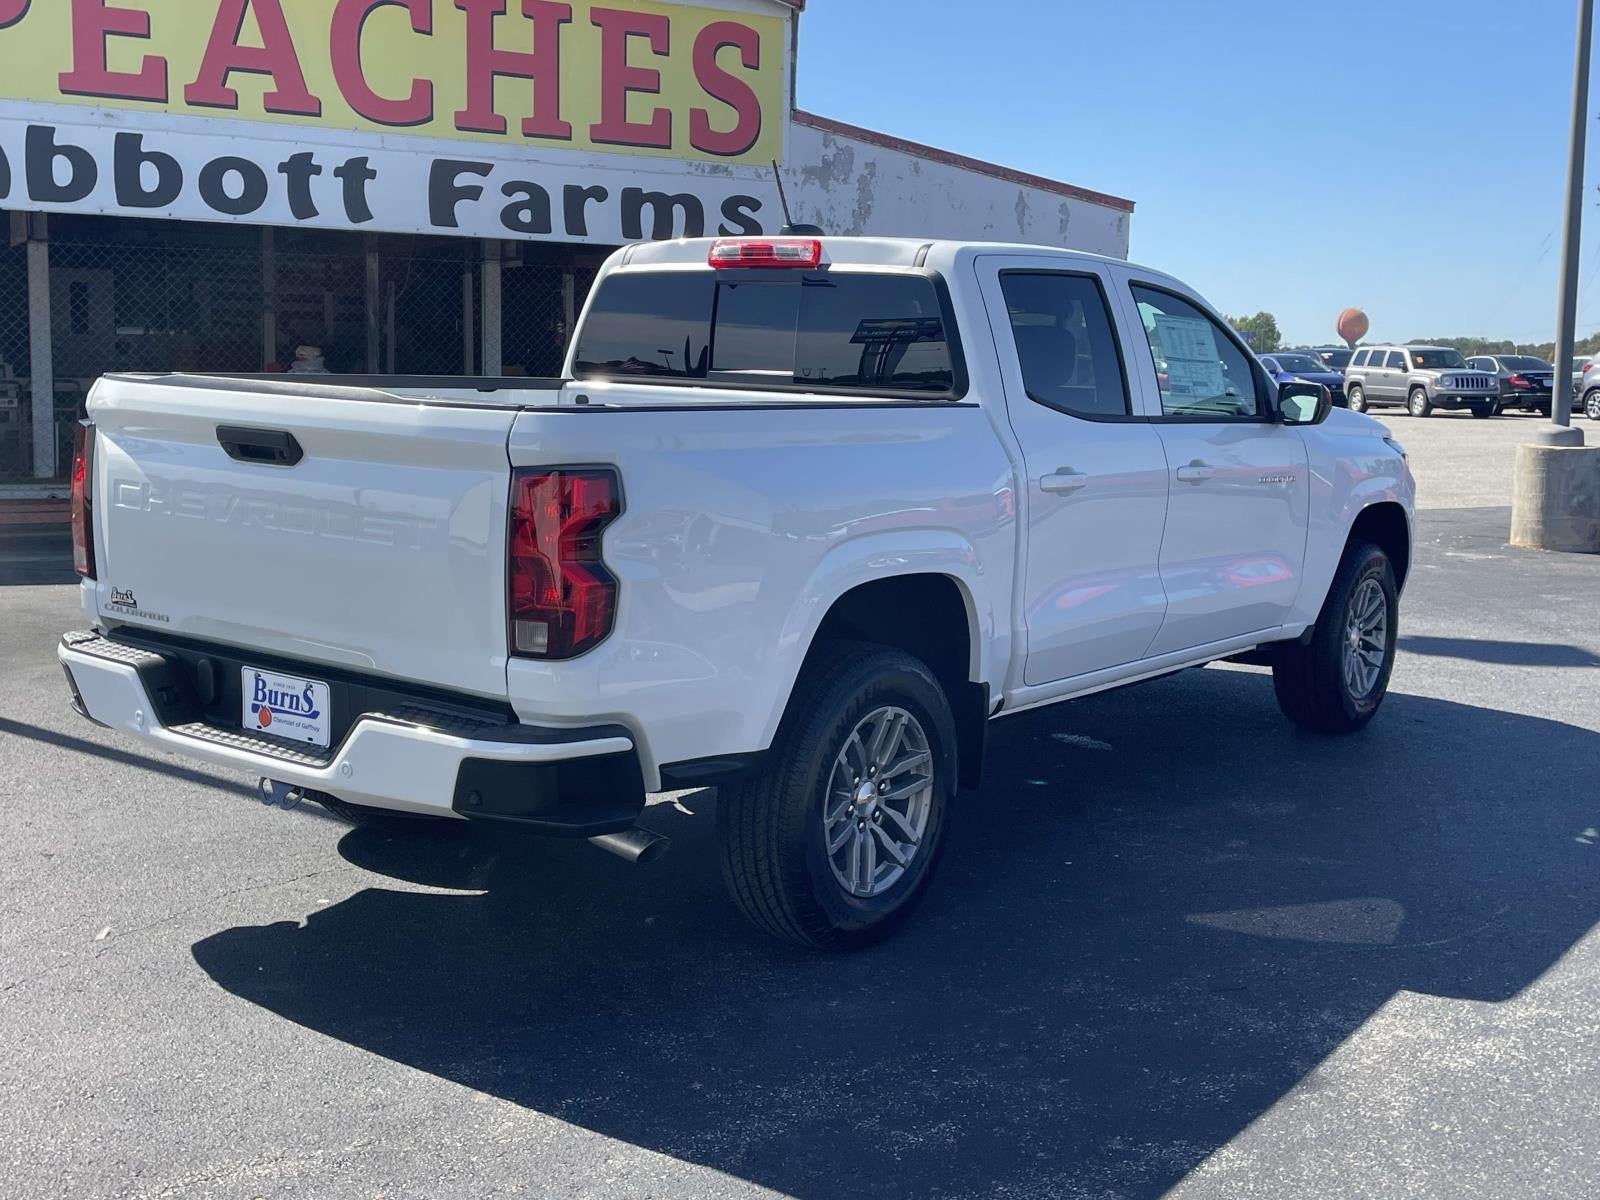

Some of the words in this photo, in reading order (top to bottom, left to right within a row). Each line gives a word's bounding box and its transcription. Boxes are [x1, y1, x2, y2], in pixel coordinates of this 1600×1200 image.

[0, 0, 761, 156] EACHES
[0, 125, 377, 223] bbott
[429, 159, 763, 240] Farms
[113, 478, 440, 549] CHEVROLET
[273, 716, 294, 726] Chevrolet
